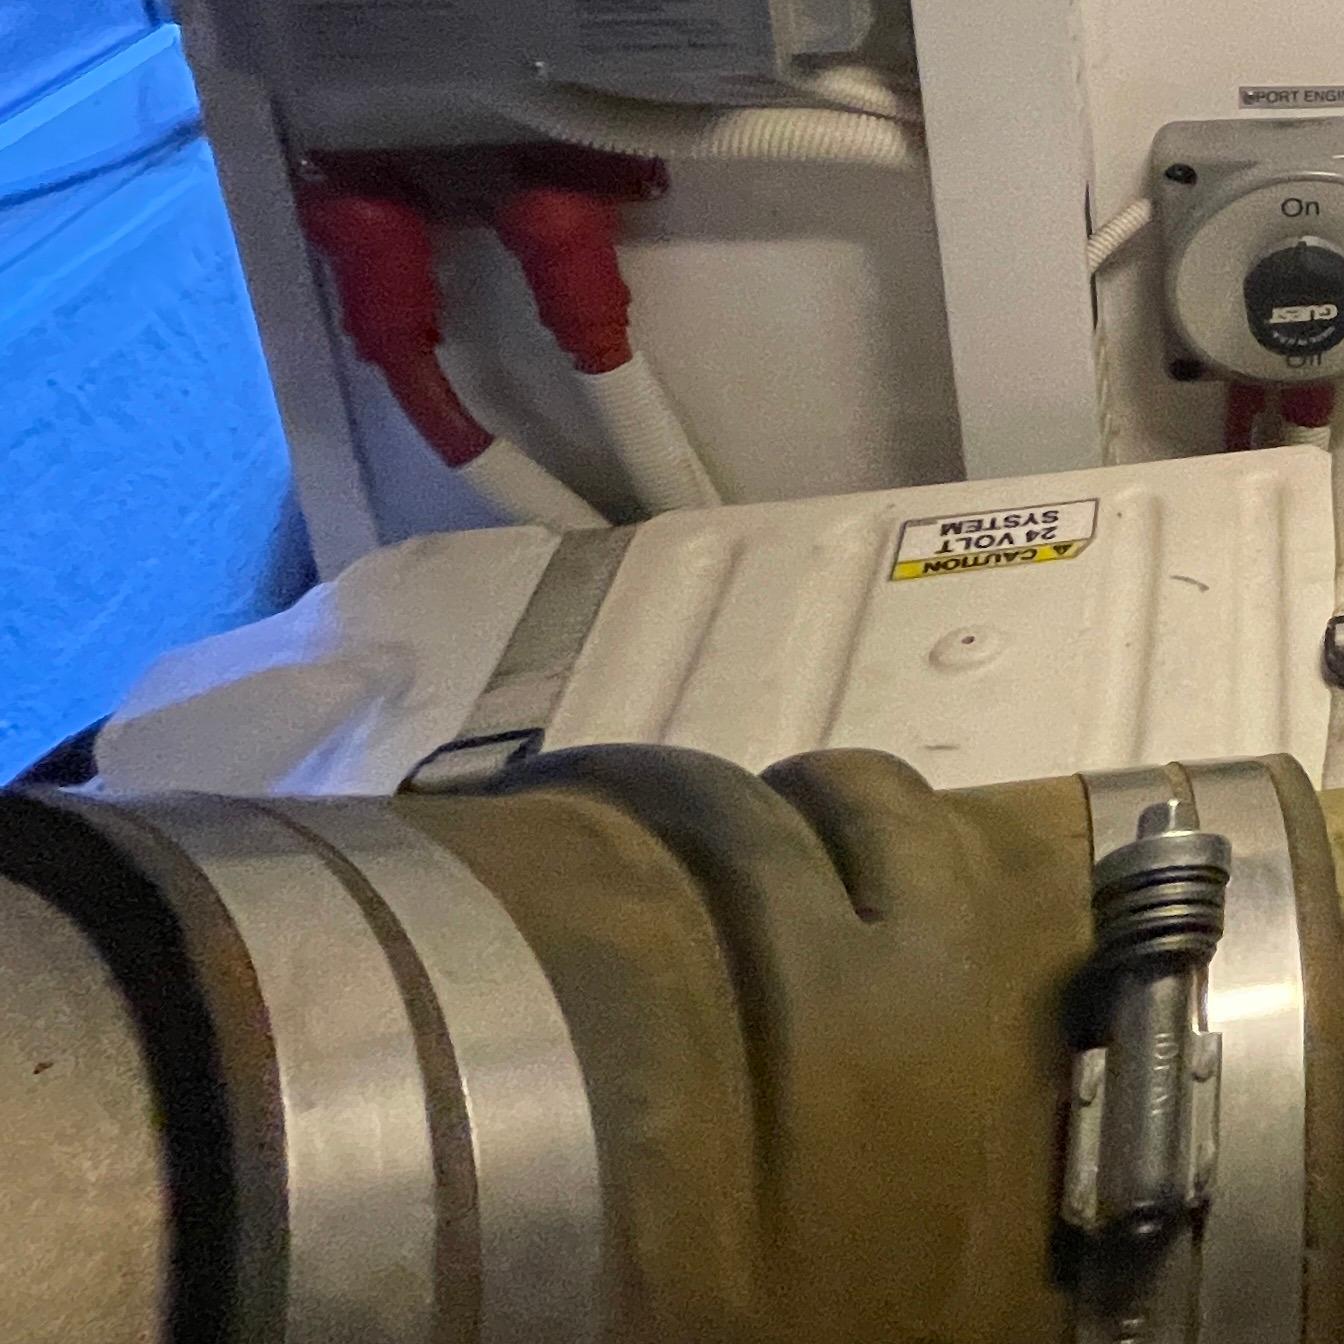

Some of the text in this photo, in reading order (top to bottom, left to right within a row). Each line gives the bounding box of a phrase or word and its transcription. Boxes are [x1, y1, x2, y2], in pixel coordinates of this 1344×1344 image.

[1255, 89, 1299, 103] PORT
[1281, 197, 1320, 217] On
[941, 510, 1059, 536] SYSTEM
[934, 526, 1058, 554] 24 VOLT
[922, 548, 1038, 573] CAUTION
